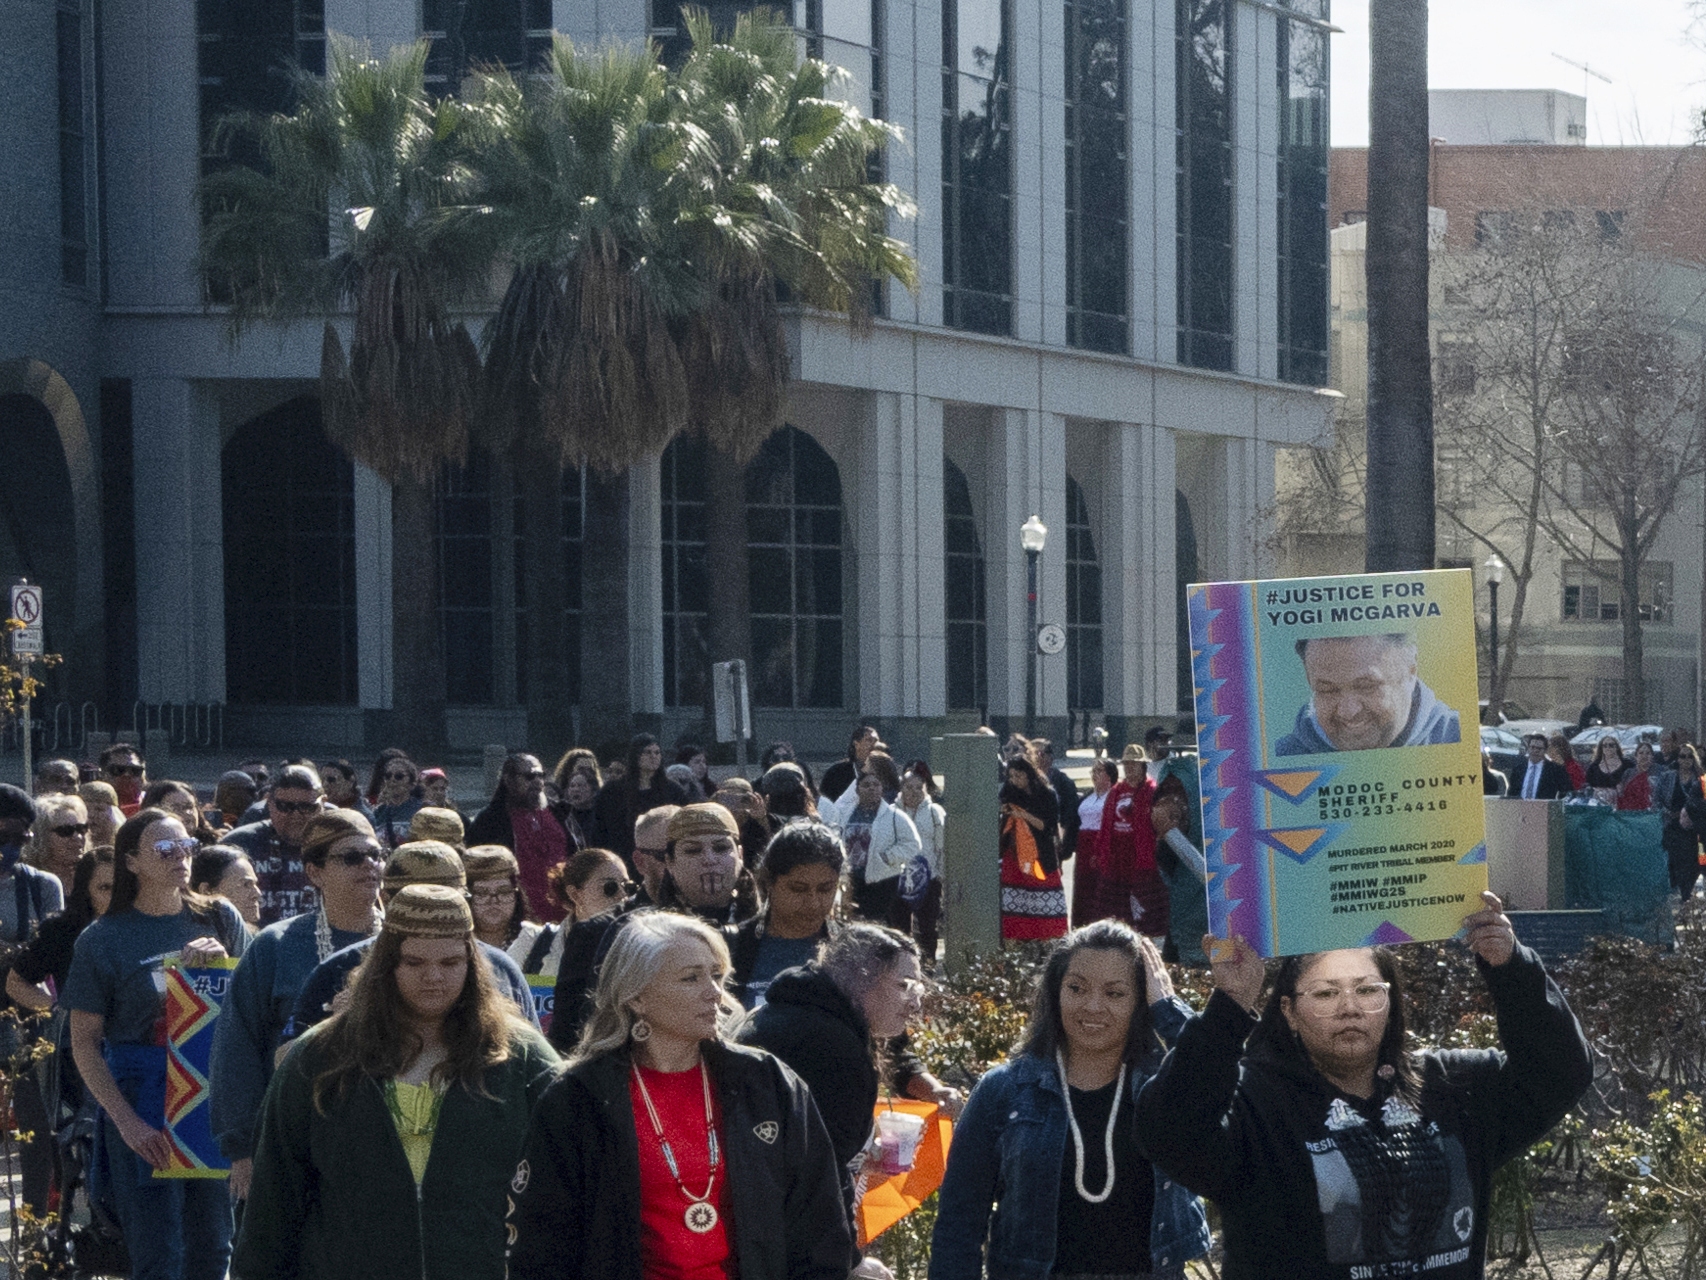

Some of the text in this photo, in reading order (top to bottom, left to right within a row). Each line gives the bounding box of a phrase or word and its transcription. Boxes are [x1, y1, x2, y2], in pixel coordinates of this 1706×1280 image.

[1266, 582, 1425, 605] #JUSTICE FOR
[1267, 602, 1441, 626] YOGI MCGARVA
[1318, 774, 1477, 797] MODOC COUNTY
[1319, 792, 1398, 808] SHERIFF
[1319, 800, 1447, 820] 530-233-4416
[1328, 840, 1456, 859] MURDERED MARCH 2020
[1350, 862, 1379, 871] RIVER
[1380, 859, 1414, 868] TRIBAL
[1415, 854, 1456, 865] MEMBER
[1330, 873, 1427, 892] #MMIW #MMIP
[1330, 887, 1406, 902] #MMIWG2S
[1332, 894, 1466, 914] #NATIVEJUSTICENOW
